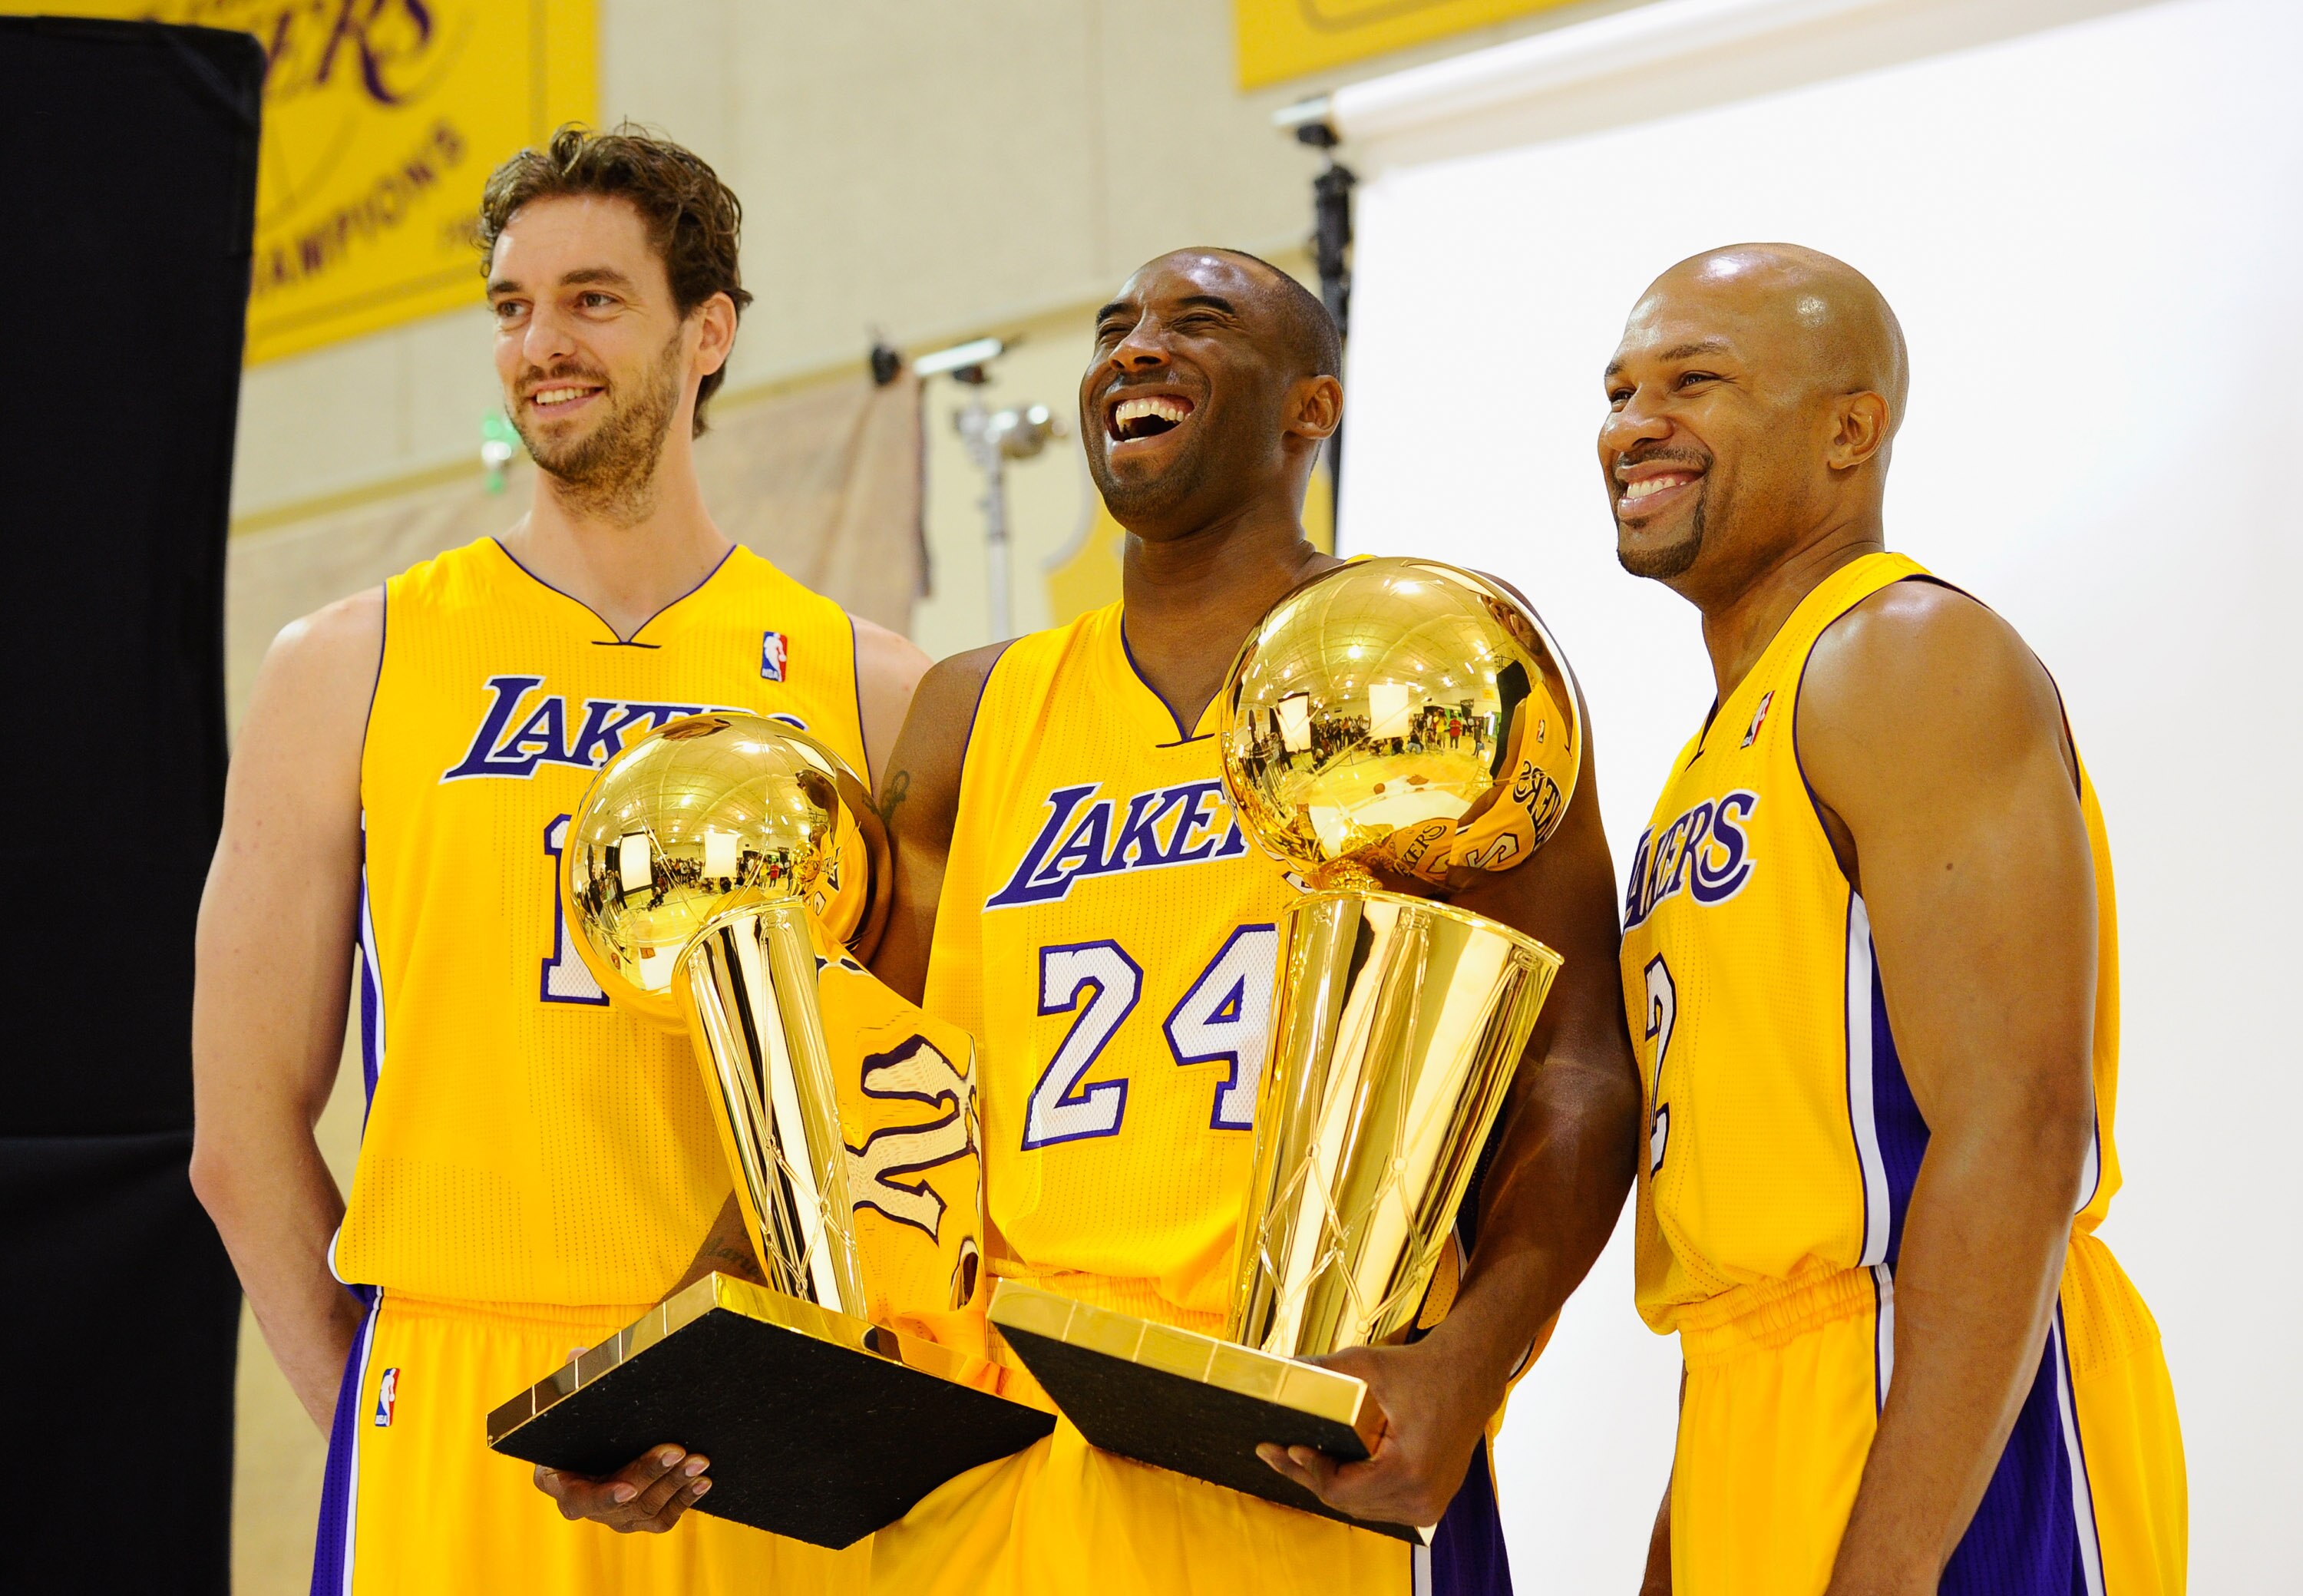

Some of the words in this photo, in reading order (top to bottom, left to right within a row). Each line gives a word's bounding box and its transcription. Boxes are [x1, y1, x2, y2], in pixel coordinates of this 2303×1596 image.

[257, 0, 439, 107] ERS
[252, 117, 466, 296] AMPIONS
[438, 675, 809, 785] LAK
[540, 813, 610, 1006] 1
[1020, 923, 1280, 1151] 24
[1644, 951, 1677, 1180] 2
